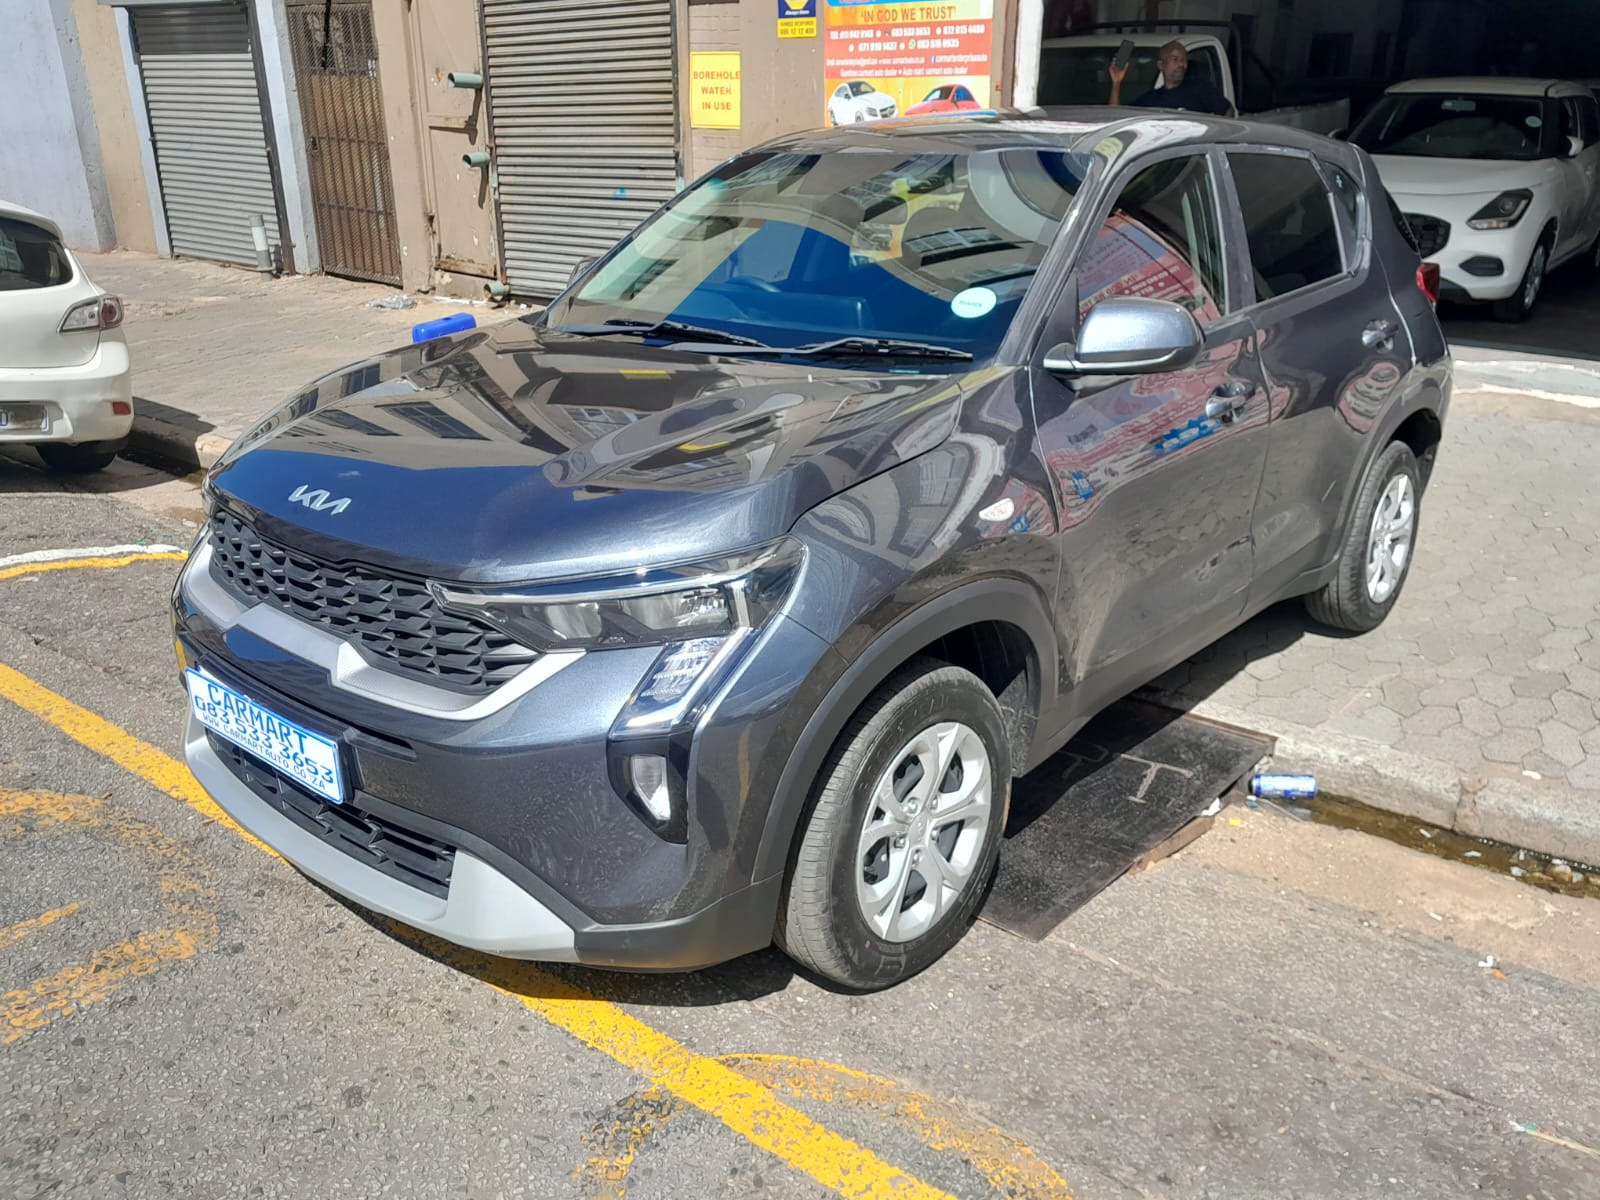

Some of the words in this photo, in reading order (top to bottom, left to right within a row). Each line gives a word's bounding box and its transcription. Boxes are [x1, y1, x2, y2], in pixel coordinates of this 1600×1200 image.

[877, 9, 898, 22] GOD
[901, 8, 916, 20] WE
[693, 71, 741, 80] BOREHOLE
[701, 86, 732, 95] WATER
[702, 101, 711, 110] IN
[713, 101, 732, 110] USE
[207, 683, 307, 755] CARMART
[194, 695, 230, 725] 083
[235, 718, 273, 750] 533
[278, 741, 334, 785] 3653
